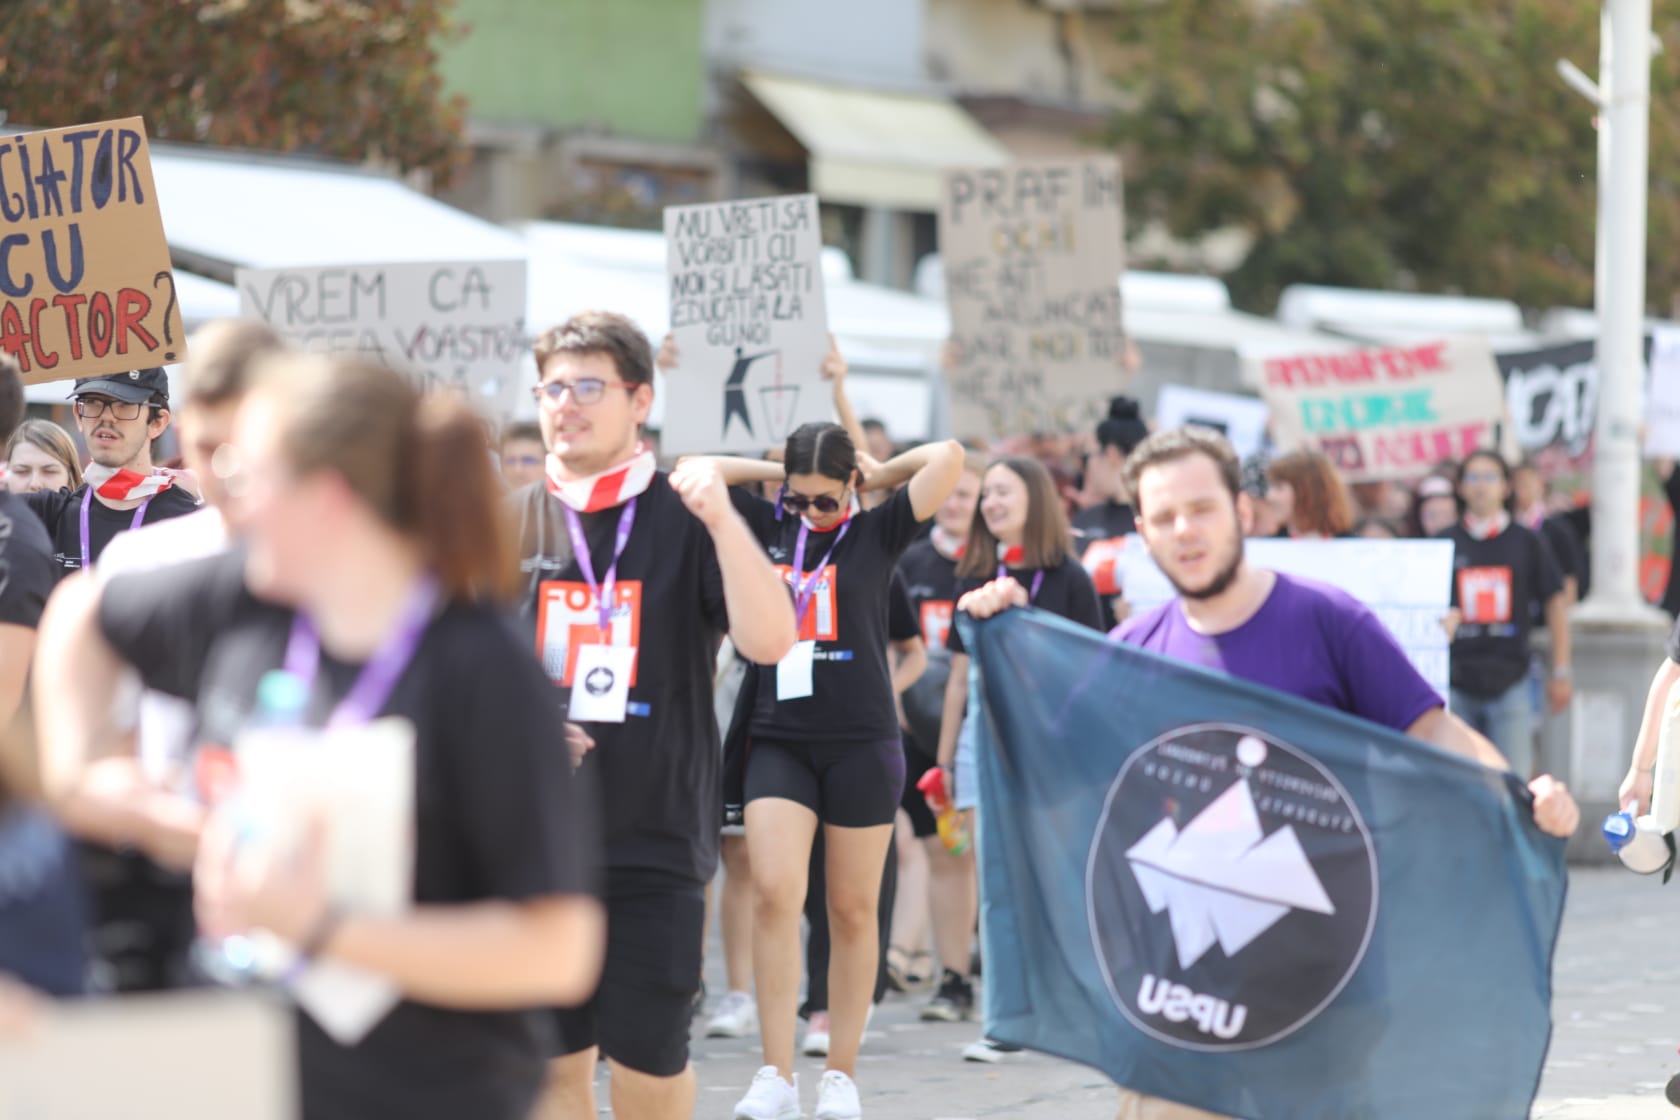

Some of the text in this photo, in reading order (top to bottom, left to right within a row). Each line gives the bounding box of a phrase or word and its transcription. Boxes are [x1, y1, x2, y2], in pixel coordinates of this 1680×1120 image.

[674, 209, 712, 239] NU
[0, 223, 84, 297] CU
[767, 233, 797, 263] CU
[244, 266, 493, 326] VREM CA
[773, 295, 804, 321] LA
[706, 322, 772, 347] GUNOI
